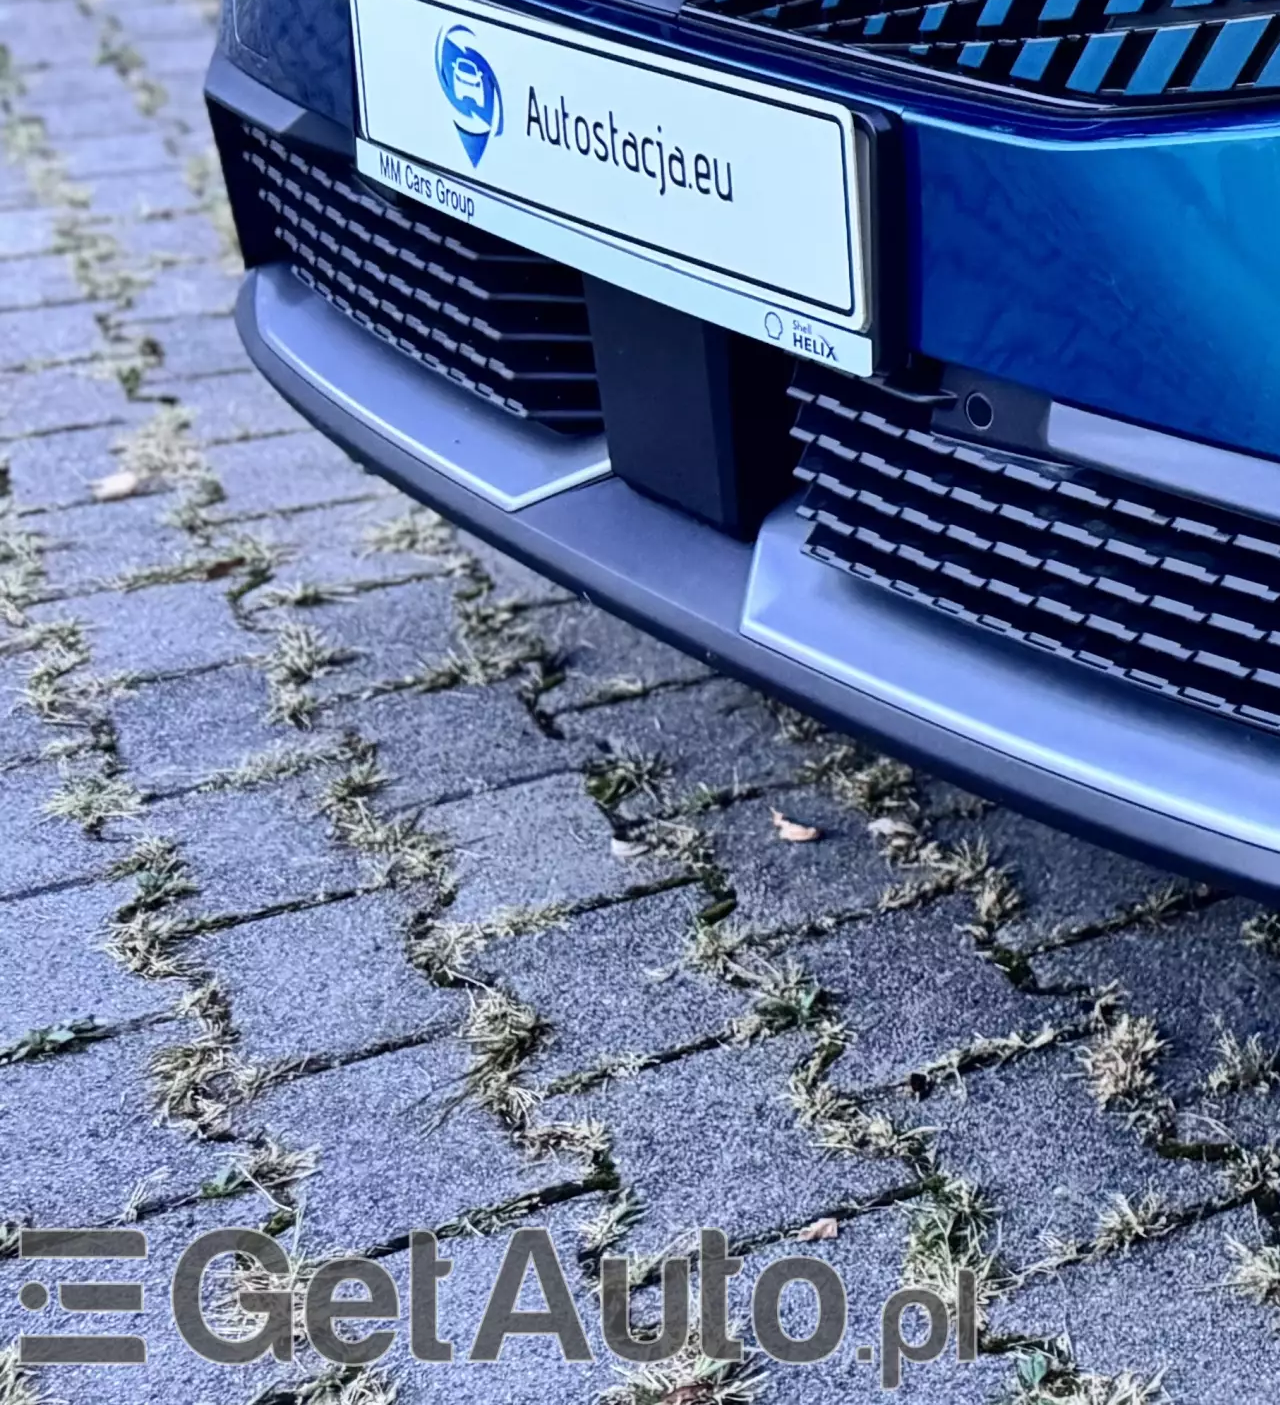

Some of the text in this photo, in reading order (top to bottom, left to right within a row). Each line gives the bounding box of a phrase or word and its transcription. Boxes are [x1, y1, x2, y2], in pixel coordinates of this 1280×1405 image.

[526, 85, 734, 203] Autostacja.eu
[379, 151, 475, 222] MM Cars Group
[792, 319, 813, 335] Shell
[792, 332, 840, 362] HELIX
